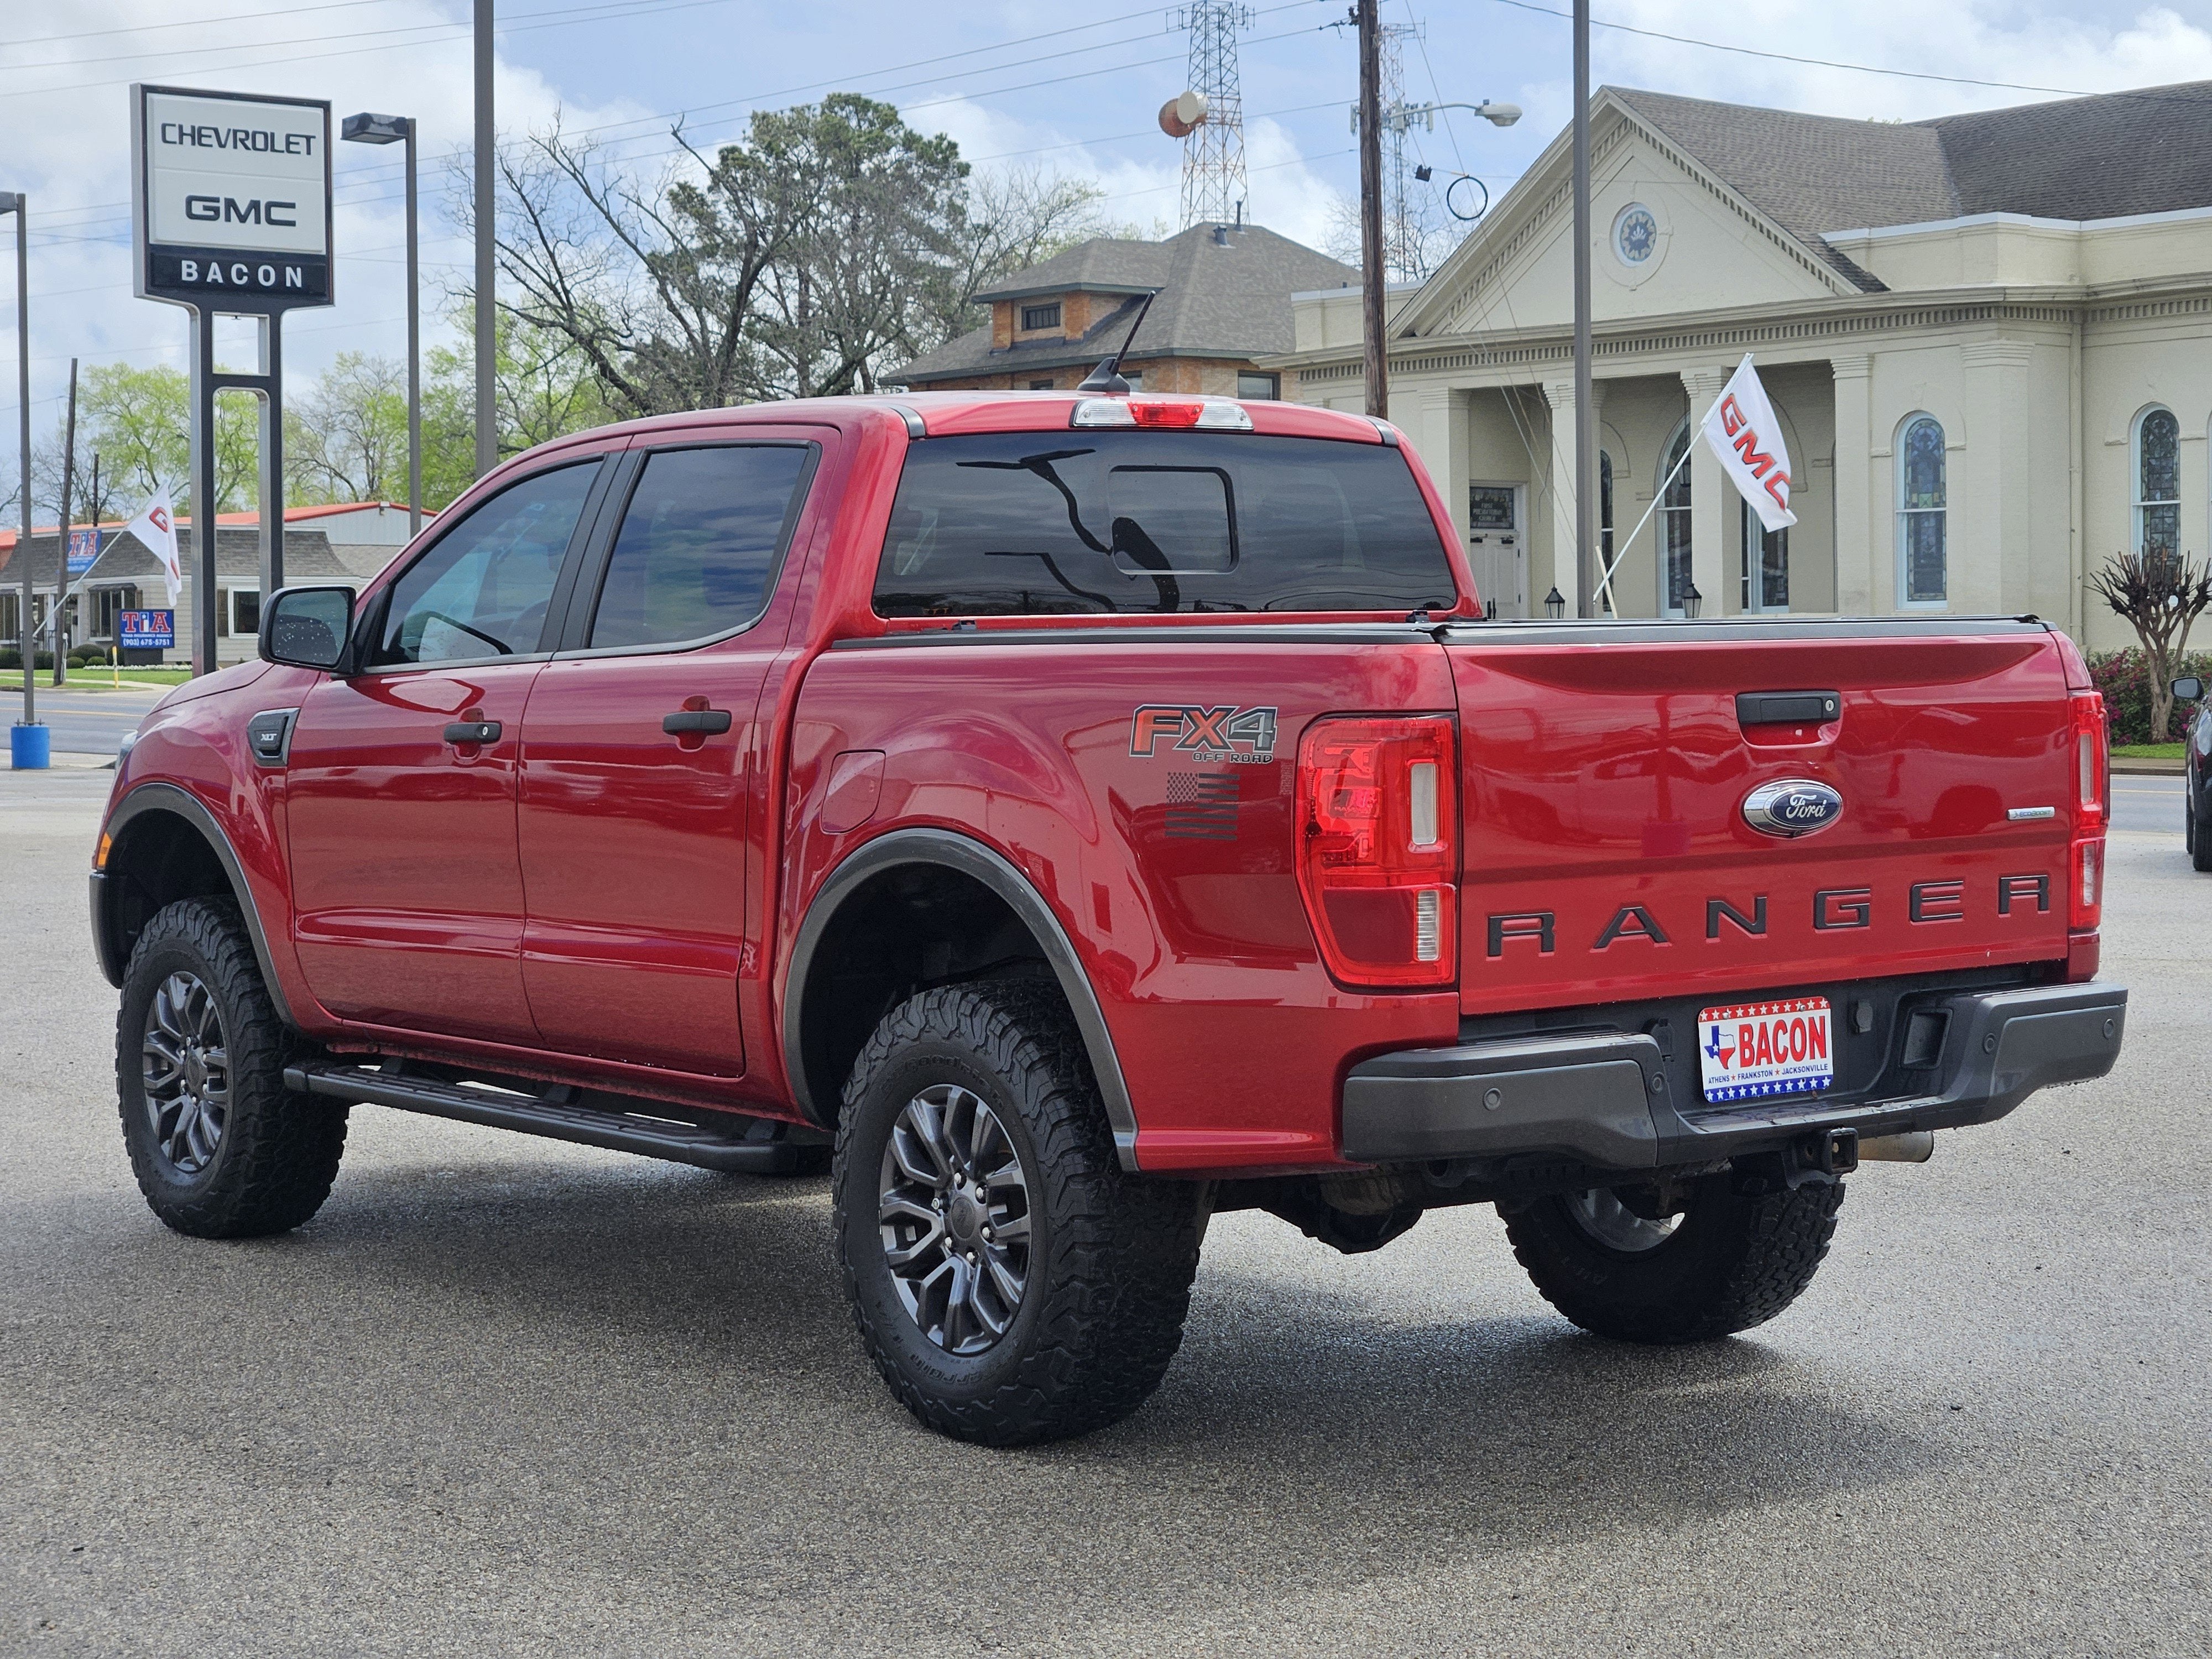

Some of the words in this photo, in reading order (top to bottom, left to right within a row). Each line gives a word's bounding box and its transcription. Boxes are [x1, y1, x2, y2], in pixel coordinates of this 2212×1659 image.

[161, 123, 316, 155] CHEVROLET
[185, 195, 296, 227] GMC
[181, 260, 302, 288] BACON
[1721, 393, 1791, 514] GMC
[123, 638, 139, 646] (903)
[1129, 703, 1278, 758] FX4
[1192, 752, 1225, 762] OFF
[1229, 753, 1274, 764] ROAD
[1786, 794, 1827, 818] Ford
[1486, 874, 2051, 961] RANGER
[1739, 1015, 1827, 1068] BACON
[1708, 1074, 1730, 1084] ATHENS
[1738, 1070, 1773, 1081] FRANKSTON
[1782, 1063, 1828, 1075] JACKSONVILLE
